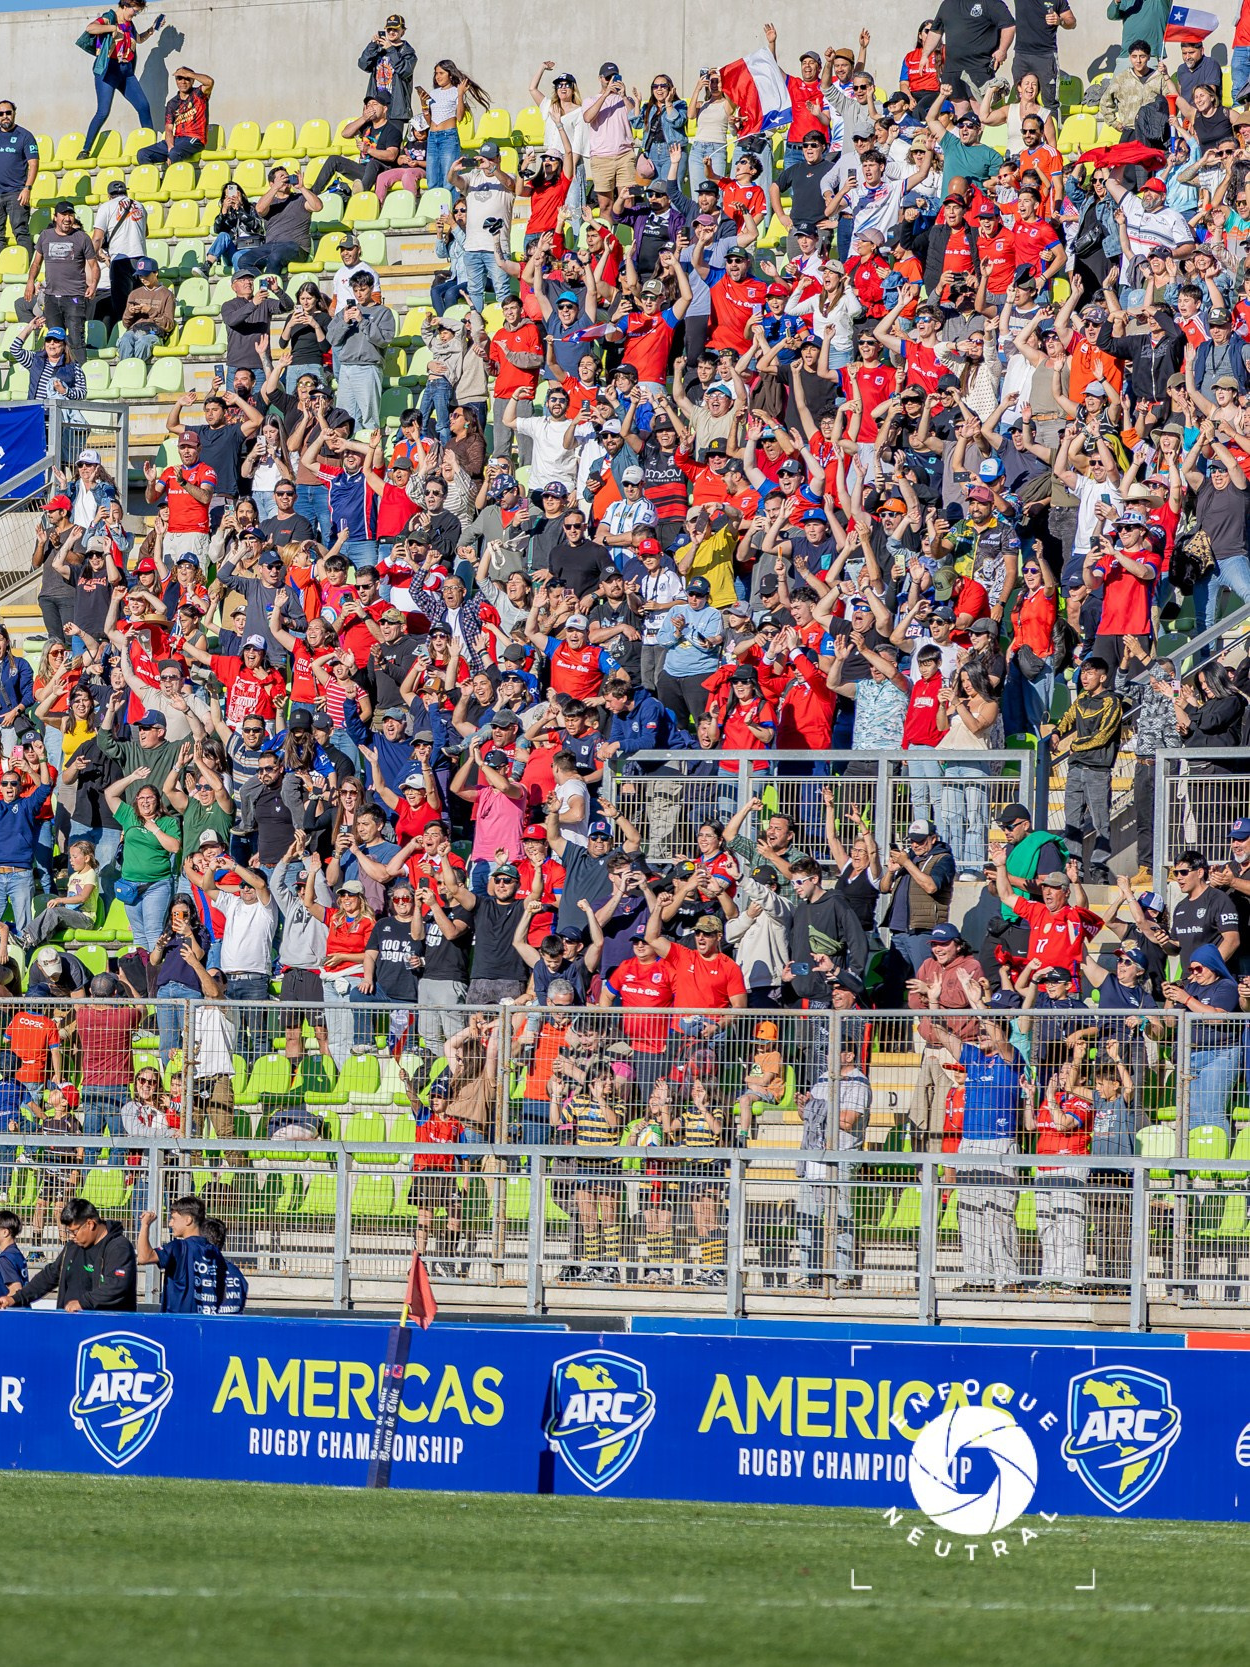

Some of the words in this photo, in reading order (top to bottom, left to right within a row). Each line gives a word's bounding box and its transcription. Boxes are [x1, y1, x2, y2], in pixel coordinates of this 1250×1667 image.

[1036, 938, 1049, 954] 17
[19, 1017, 45, 1029] COPEC
[888, 1091, 898, 1107] D
[84, 1370, 157, 1406] ARC
[386, 1387, 400, 1414] Chile
[386, 1415, 395, 1428] de
[560, 1391, 638, 1428] ARC
[1076, 1407, 1163, 1446] ARC
[249, 1426, 311, 1458] RUGBY
[317, 1430, 464, 1465] CHAMONSHIP
[379, 1429, 393, 1463] Banco
[738, 1448, 804, 1478] RUGBY
[812, 1450, 973, 1484] CHAMPIOIP
